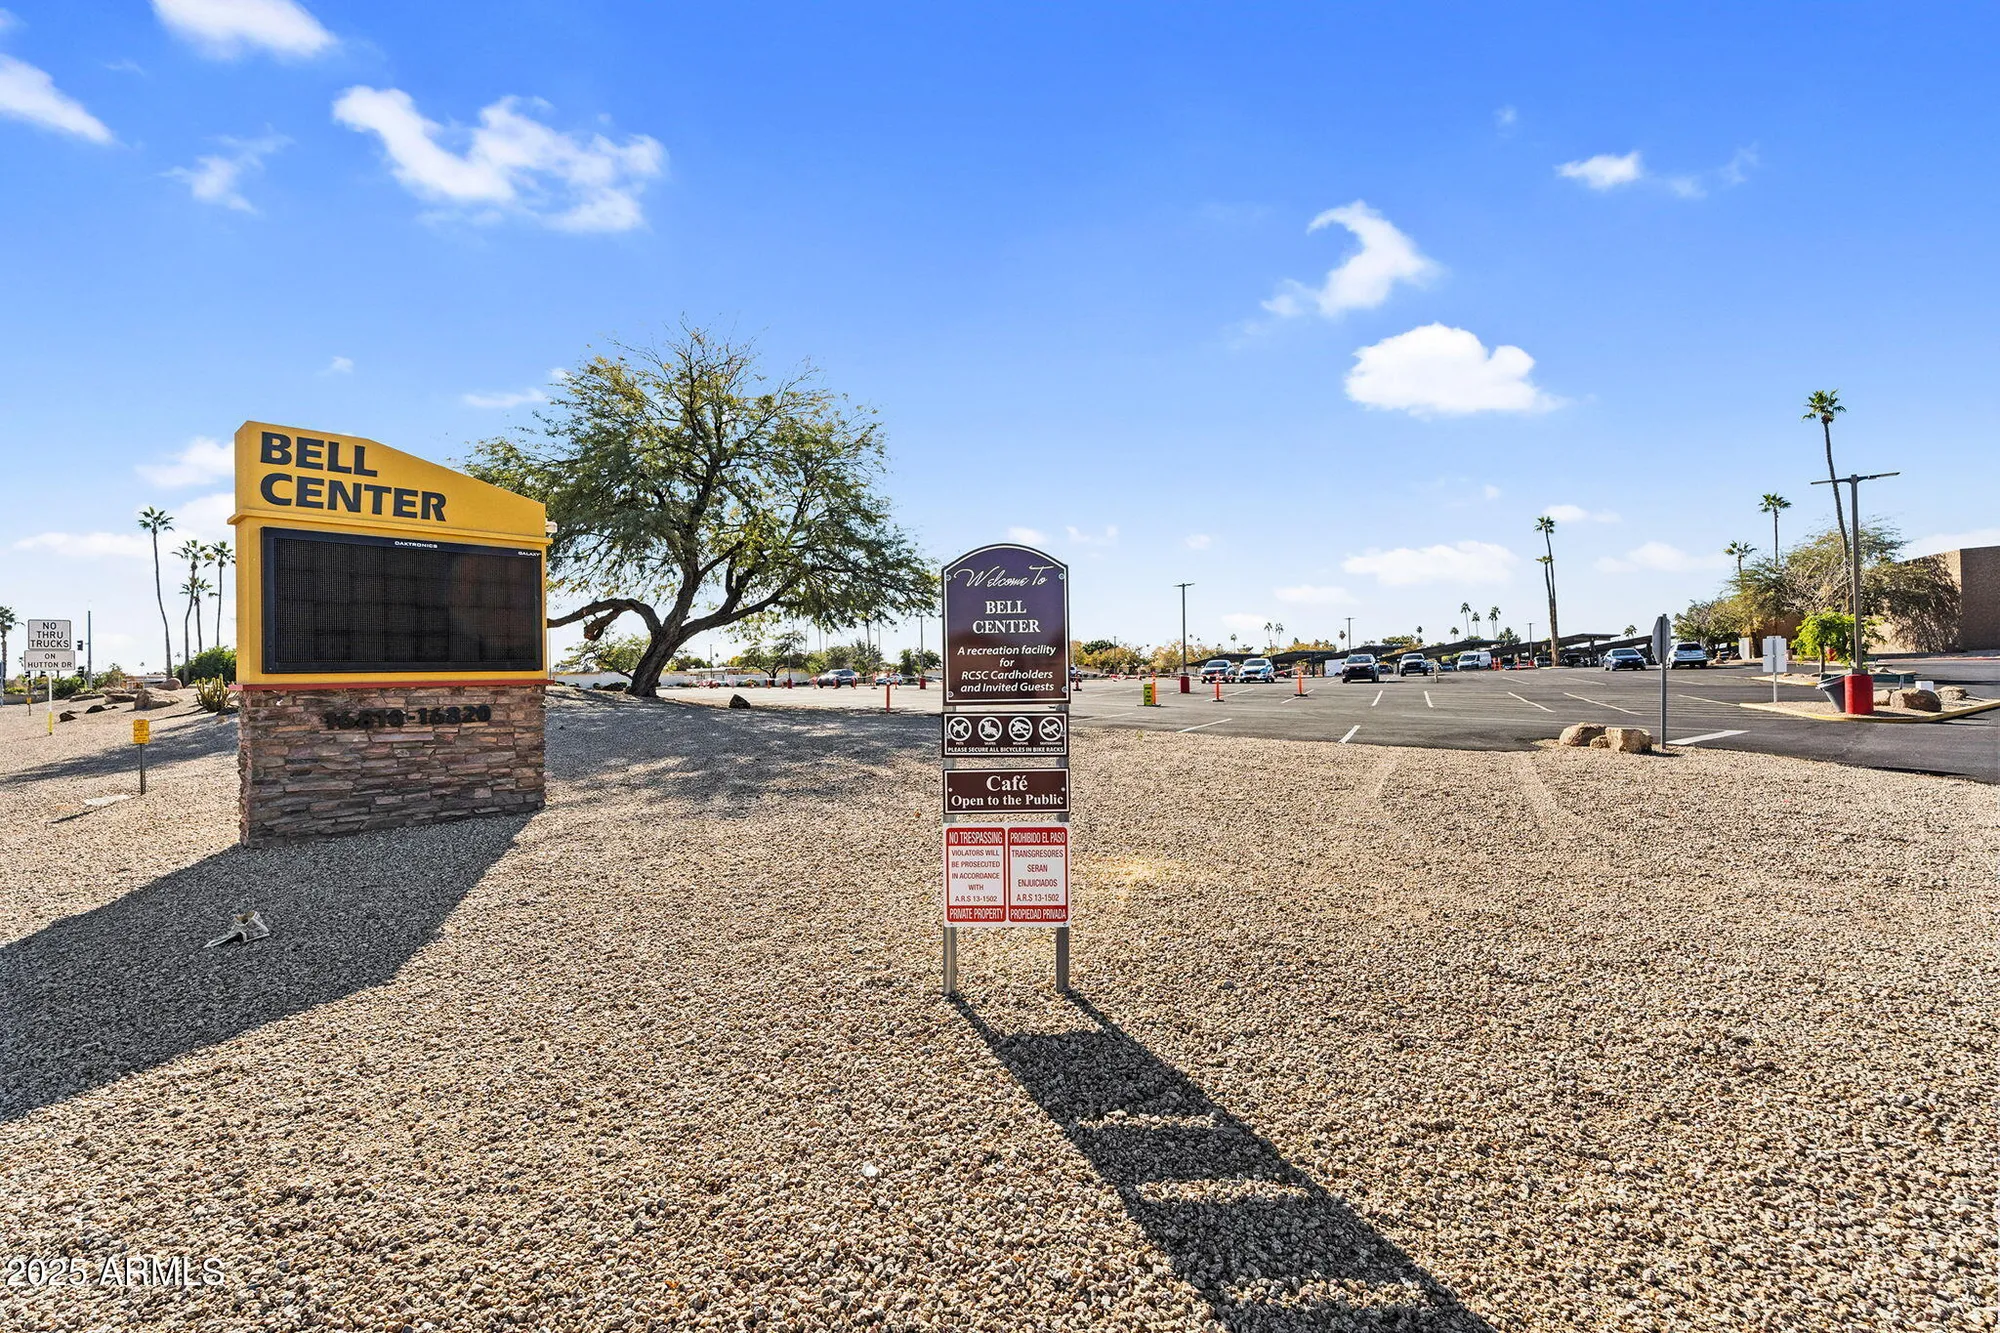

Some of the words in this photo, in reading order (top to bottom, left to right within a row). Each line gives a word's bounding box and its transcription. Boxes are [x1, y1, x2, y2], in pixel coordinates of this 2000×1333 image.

[260, 431, 378, 477] BELL
[260, 473, 447, 522] CENTER
[953, 565, 1030, 588] Welcome
[1028, 565, 1055, 586] To
[985, 600, 1027, 614] BELL
[42, 622, 57, 630] NO
[972, 619, 1041, 634] CENTER
[36, 631, 64, 639] THRU
[31, 640, 69, 648] TRUCKS
[957, 646, 965, 655] A
[966, 645, 1020, 655] recreation
[1021, 644, 1057, 656] facility
[999, 657, 1015, 667] for
[961, 671, 989, 680] RCSC
[990, 669, 1053, 680] Cardholders
[960, 682, 980, 692] and
[982, 683, 1018, 692] Invited
[1020, 682, 1055, 692] Guests
[986, 775, 1028, 791] Café
[951, 795, 984, 808] Open
[987, 796, 999, 805] to
[1002, 795, 1022, 805] the
[1025, 794, 1064, 805] Public
[949, 832, 959, 844] NO
[960, 831, 1003, 844] TRESPASSING
[1010, 832, 1040, 843] PROHIBIDO
[1041, 832, 1049, 843] EL
[1050, 832, 1066, 843] PASO
[1011, 849, 1064, 858] TRANSGRESORES
[1027, 864, 1048, 873] SERAN
[1018, 879, 1058, 887] ENJUICIADOS
[1034, 893, 1059, 902] 13-1502
[949, 908, 972, 920] PRIVATE
[973, 907, 1004, 920] PROPERTY
[1010, 908, 1041, 920] PROPIEDAD
[1042, 908, 1067, 919] PRIVADA
